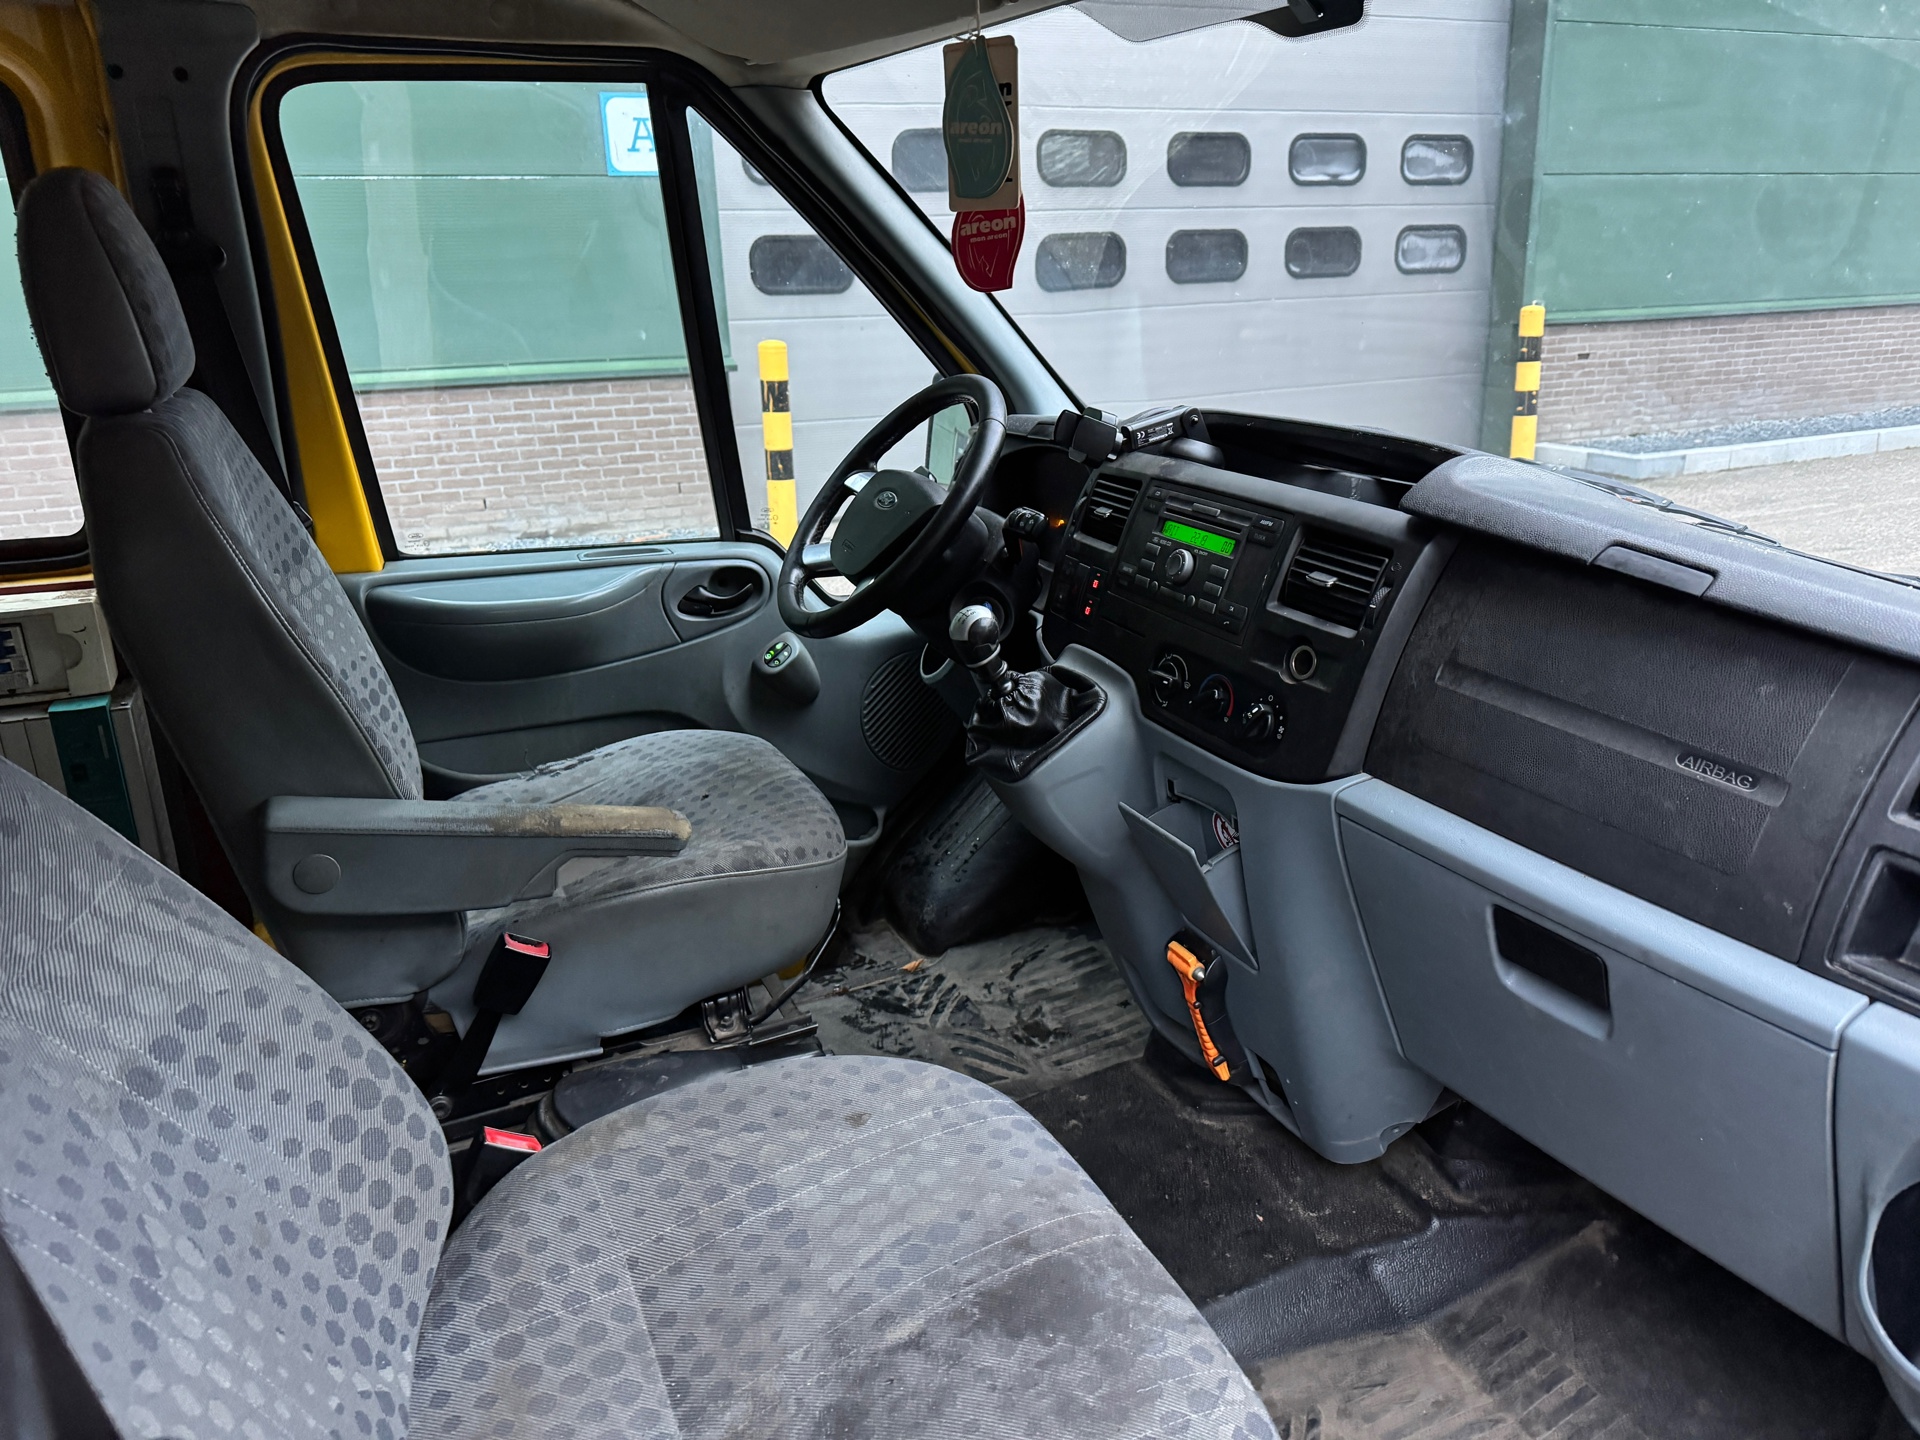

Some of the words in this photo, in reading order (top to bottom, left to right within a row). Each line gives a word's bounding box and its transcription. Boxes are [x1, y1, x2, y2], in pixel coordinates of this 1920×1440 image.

[949, 121, 1003, 135] areon
[960, 216, 1017, 237] areon
[1681, 755, 1753, 789] AIRBAG
